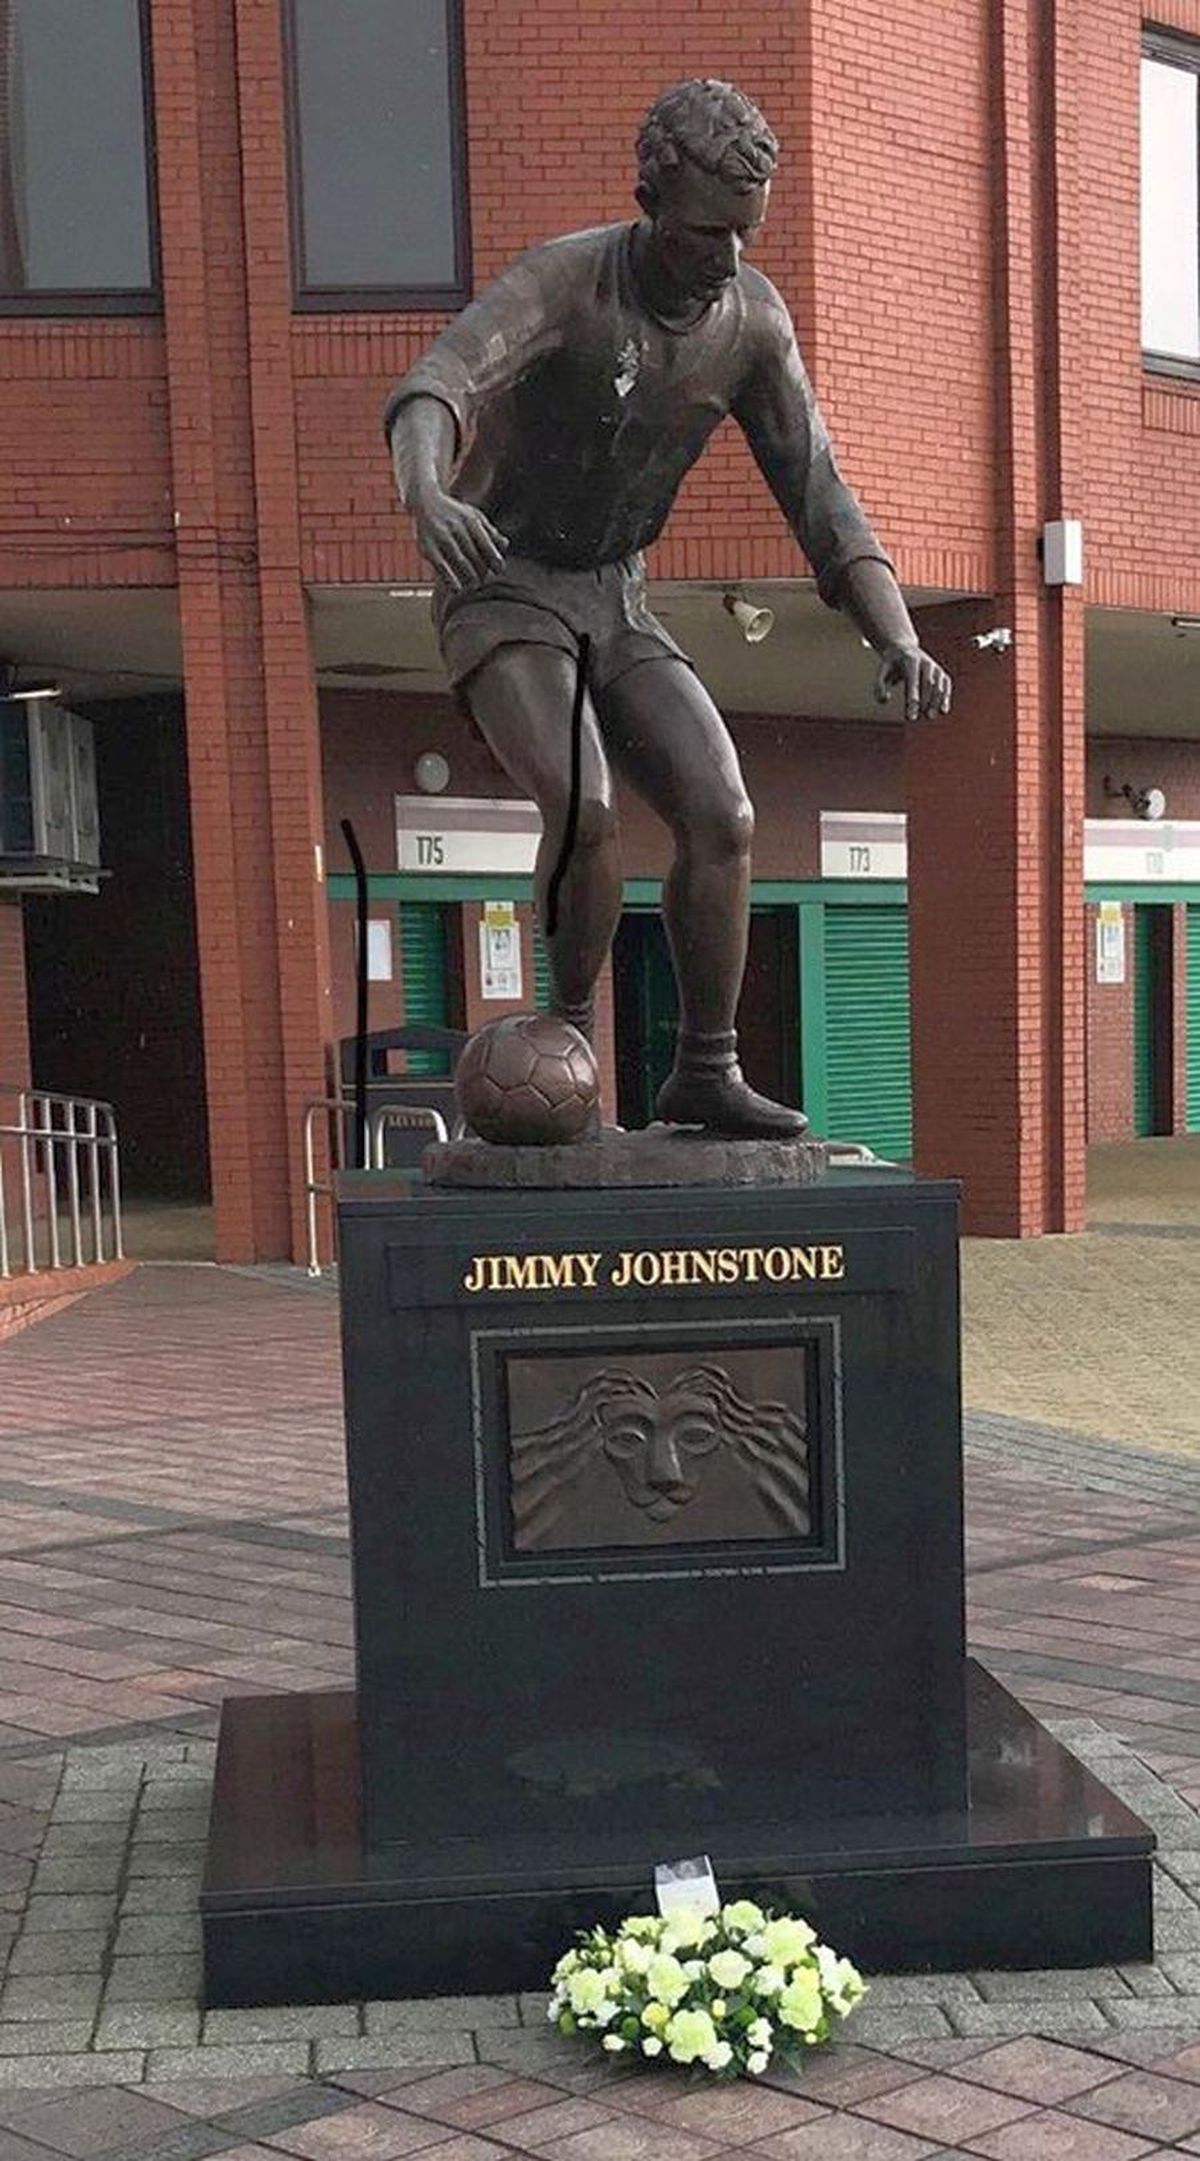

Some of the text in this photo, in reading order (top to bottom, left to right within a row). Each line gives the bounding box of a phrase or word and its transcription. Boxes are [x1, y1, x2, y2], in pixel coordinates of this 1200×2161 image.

[416, 836, 443, 865] T75
[848, 847, 870, 872] T73
[464, 1246, 845, 1292] JIMMY JOHNSTONE
